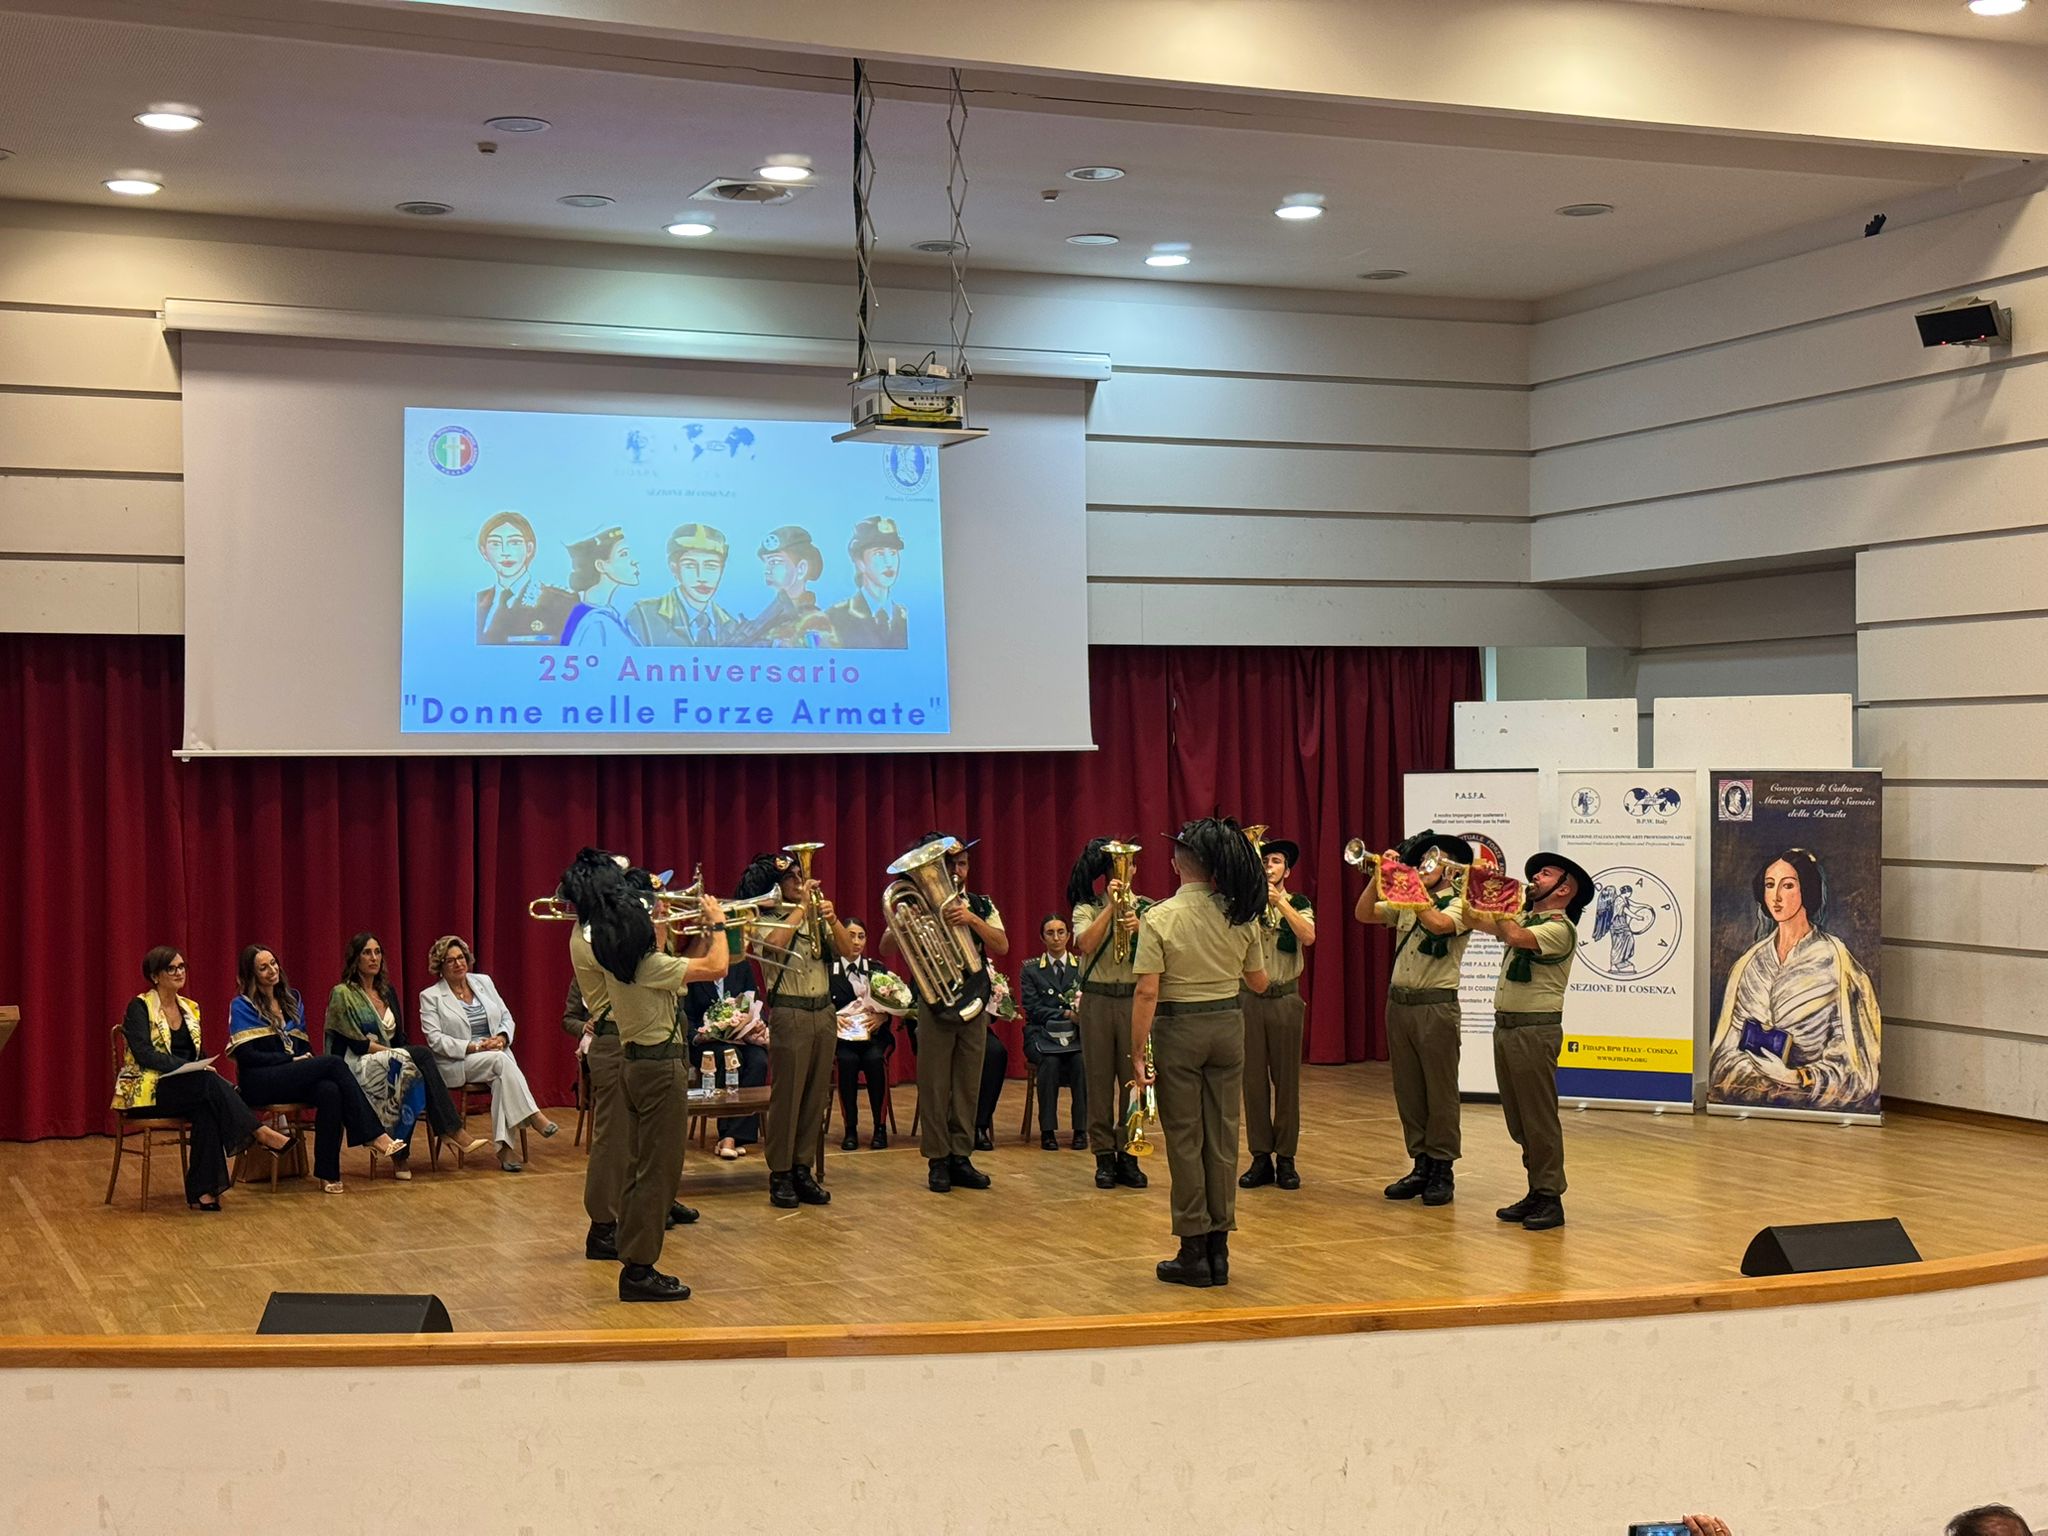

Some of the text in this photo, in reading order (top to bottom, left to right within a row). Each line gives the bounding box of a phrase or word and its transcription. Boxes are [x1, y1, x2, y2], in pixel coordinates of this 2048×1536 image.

[538, 655, 860, 684] 25° Anniversario
[404, 694, 941, 726] "Donne nelle Forze Armate"
[1816, 783, 1826, 793] di
[1828, 783, 1863, 793] Cultura
[1455, 792, 1487, 800] P.A.S.F.A.
[1759, 796, 1876, 806] Maria Cristina di Savoia
[1787, 809, 1810, 818] della
[1570, 983, 1677, 995] SEZIONE DI COSENZA
[1647, 1047, 1679, 1055] COSENZA
